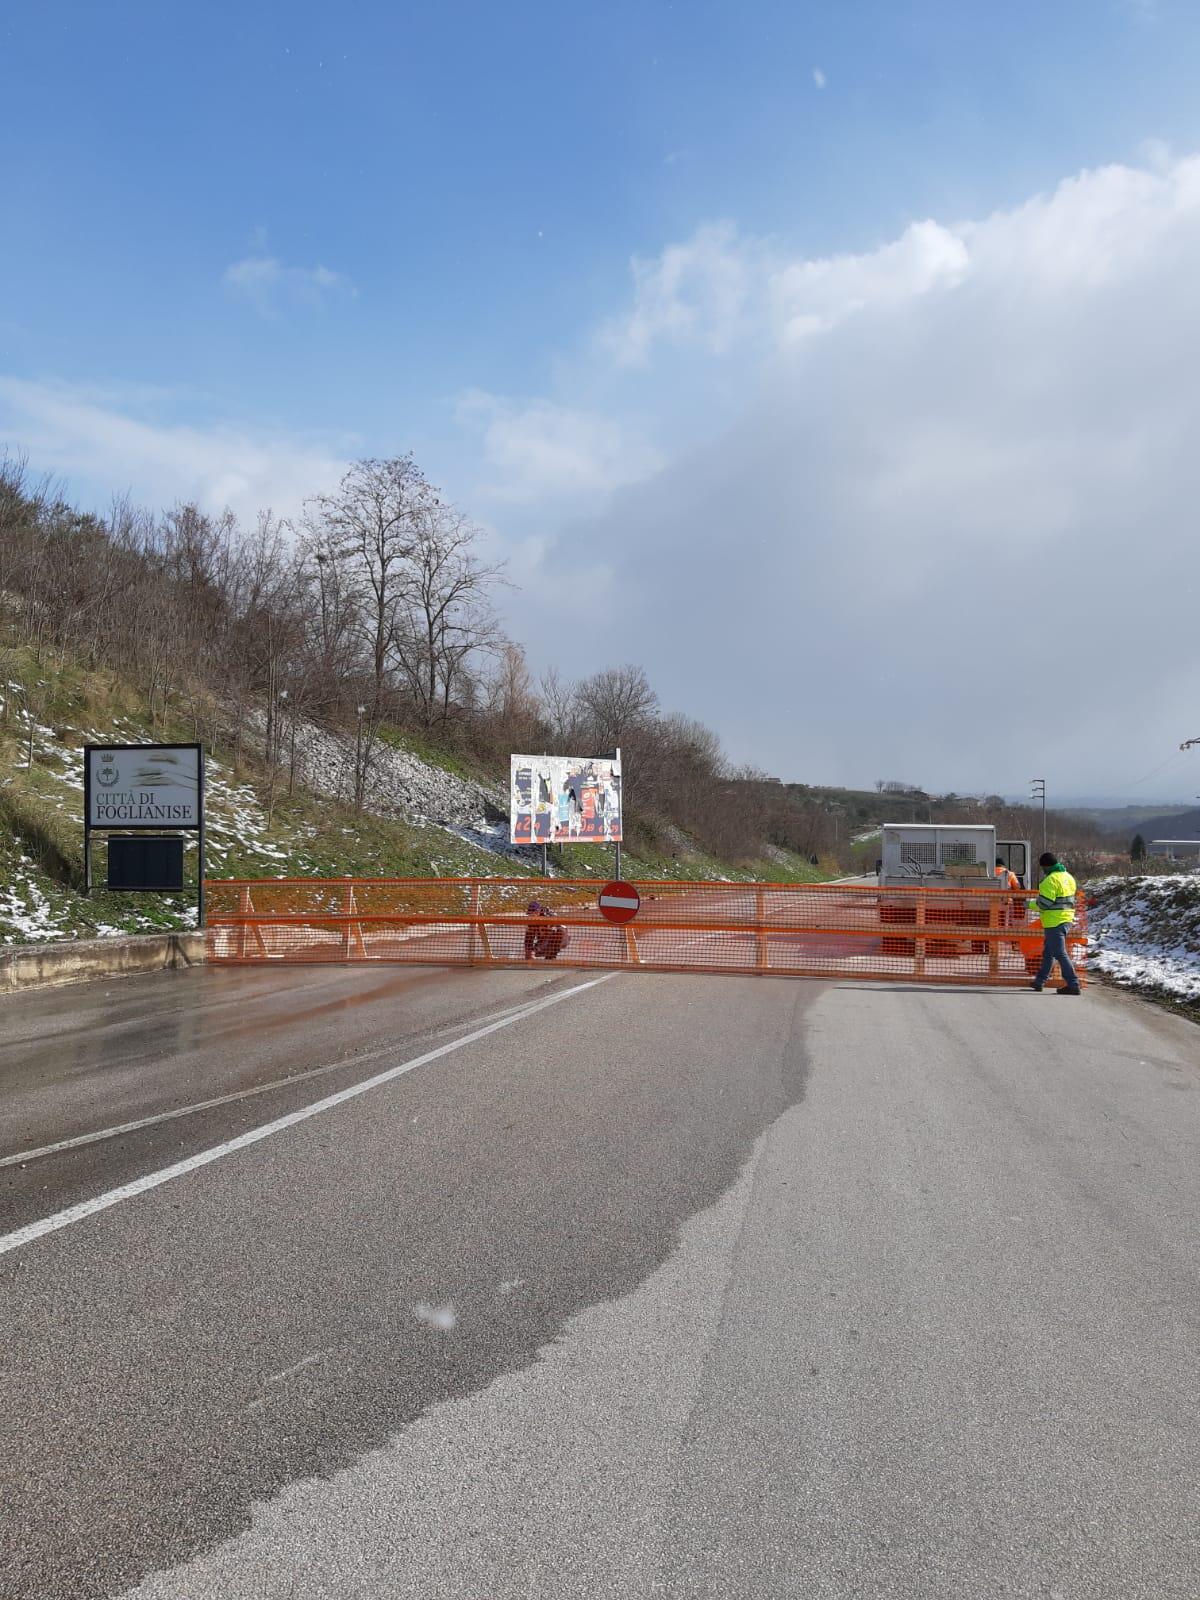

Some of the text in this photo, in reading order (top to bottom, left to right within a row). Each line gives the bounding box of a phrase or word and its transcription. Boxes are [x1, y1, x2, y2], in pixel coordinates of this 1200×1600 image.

[96, 790, 155, 805] CITTÀ DI
[96, 805, 192, 819] FOGLIANISE
